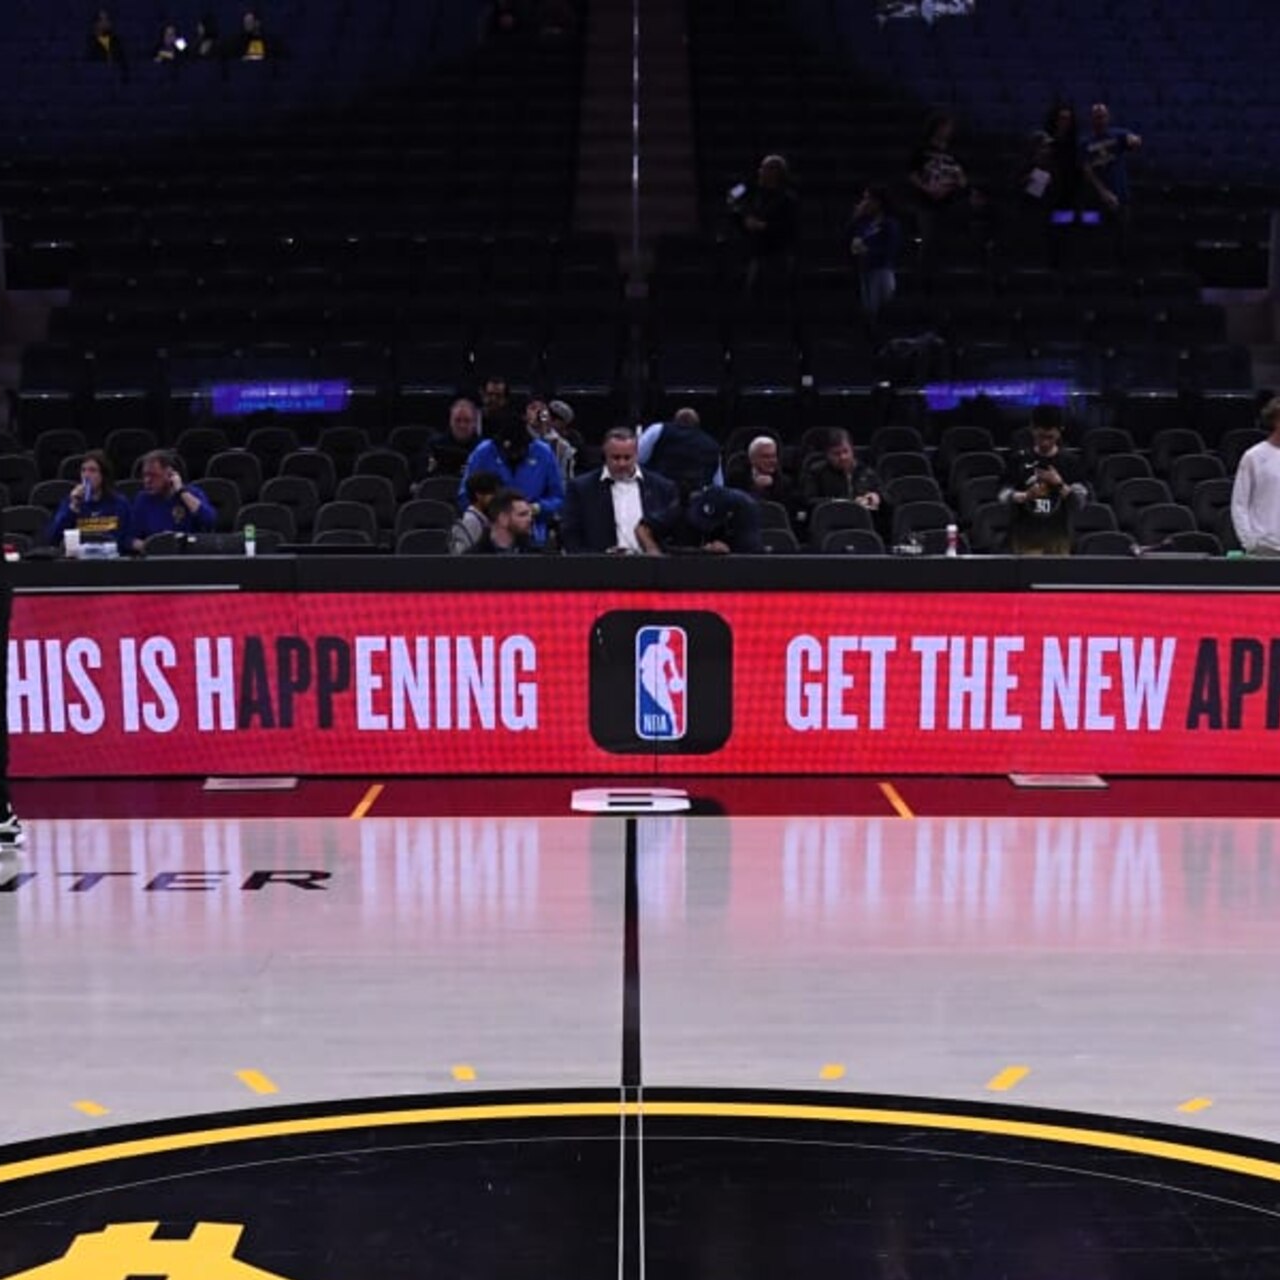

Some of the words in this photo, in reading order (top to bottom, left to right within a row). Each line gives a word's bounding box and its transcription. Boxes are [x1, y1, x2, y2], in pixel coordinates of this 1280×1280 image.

[7, 638, 105, 734] HIS
[120, 637, 180, 734] IS
[196, 635, 538, 732] HAPPENING
[785, 634, 896, 732] GET
[911, 637, 1025, 731] THE
[1040, 637, 1177, 731] NEW
